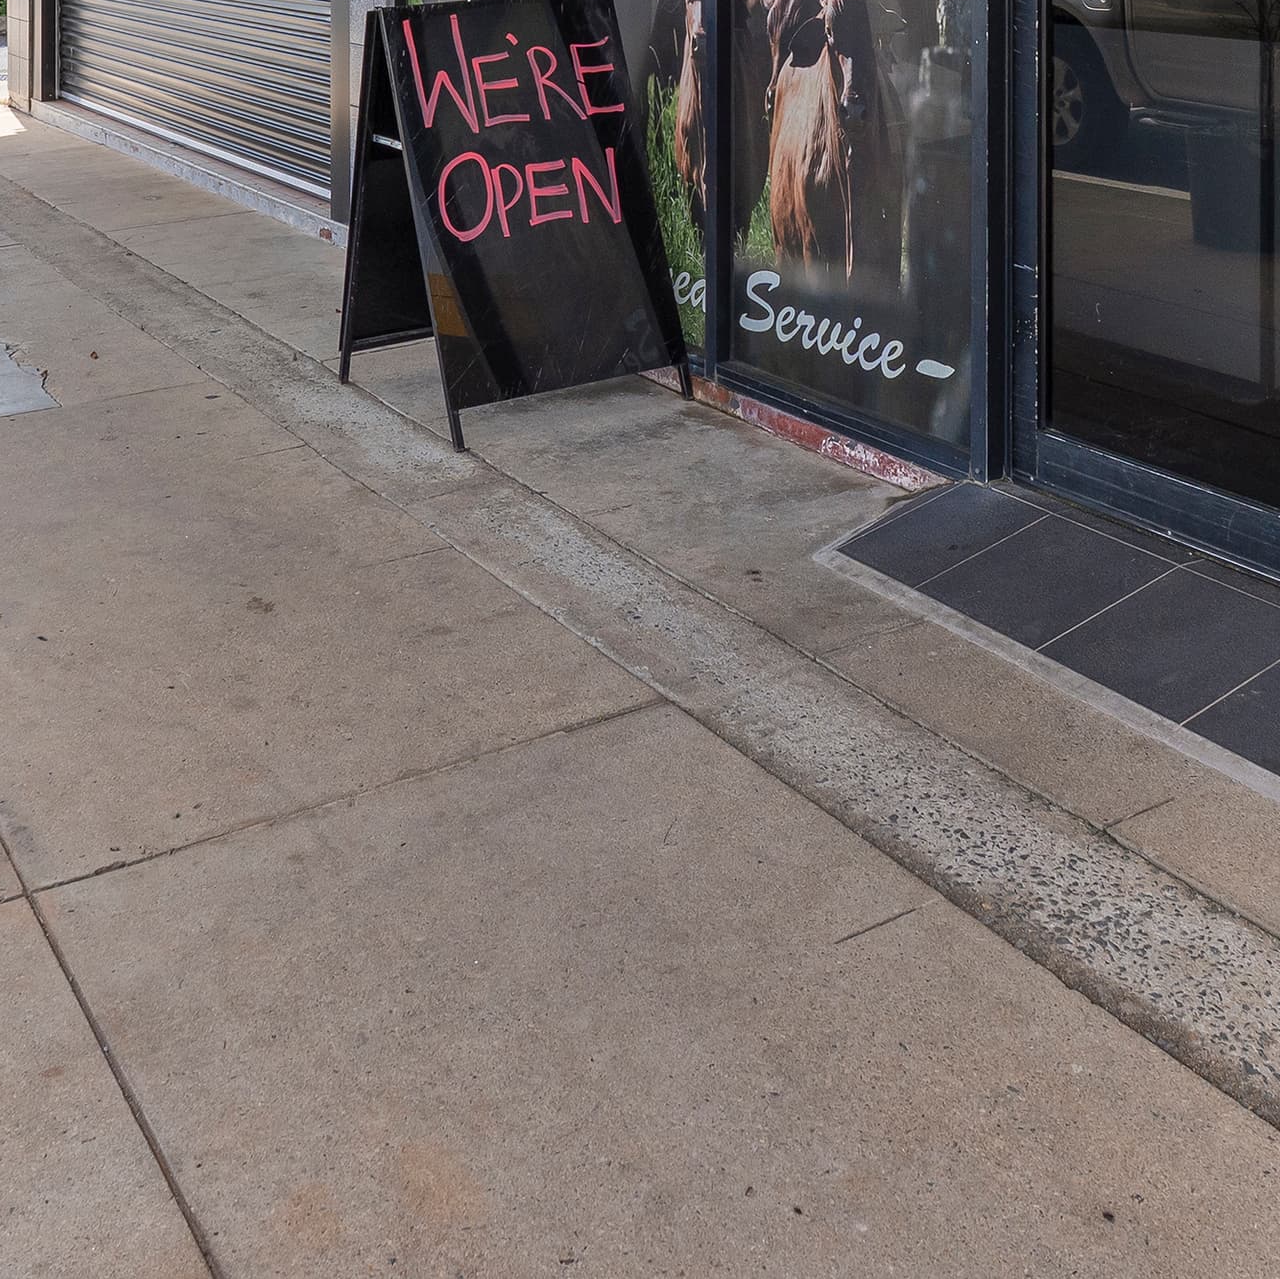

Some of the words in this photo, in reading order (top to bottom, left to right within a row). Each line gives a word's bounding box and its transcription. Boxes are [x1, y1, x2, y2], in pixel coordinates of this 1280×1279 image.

[402, 14, 625, 134] WE'RE
[438, 147, 622, 242] OPEN
[739, 270, 906, 379] Service
